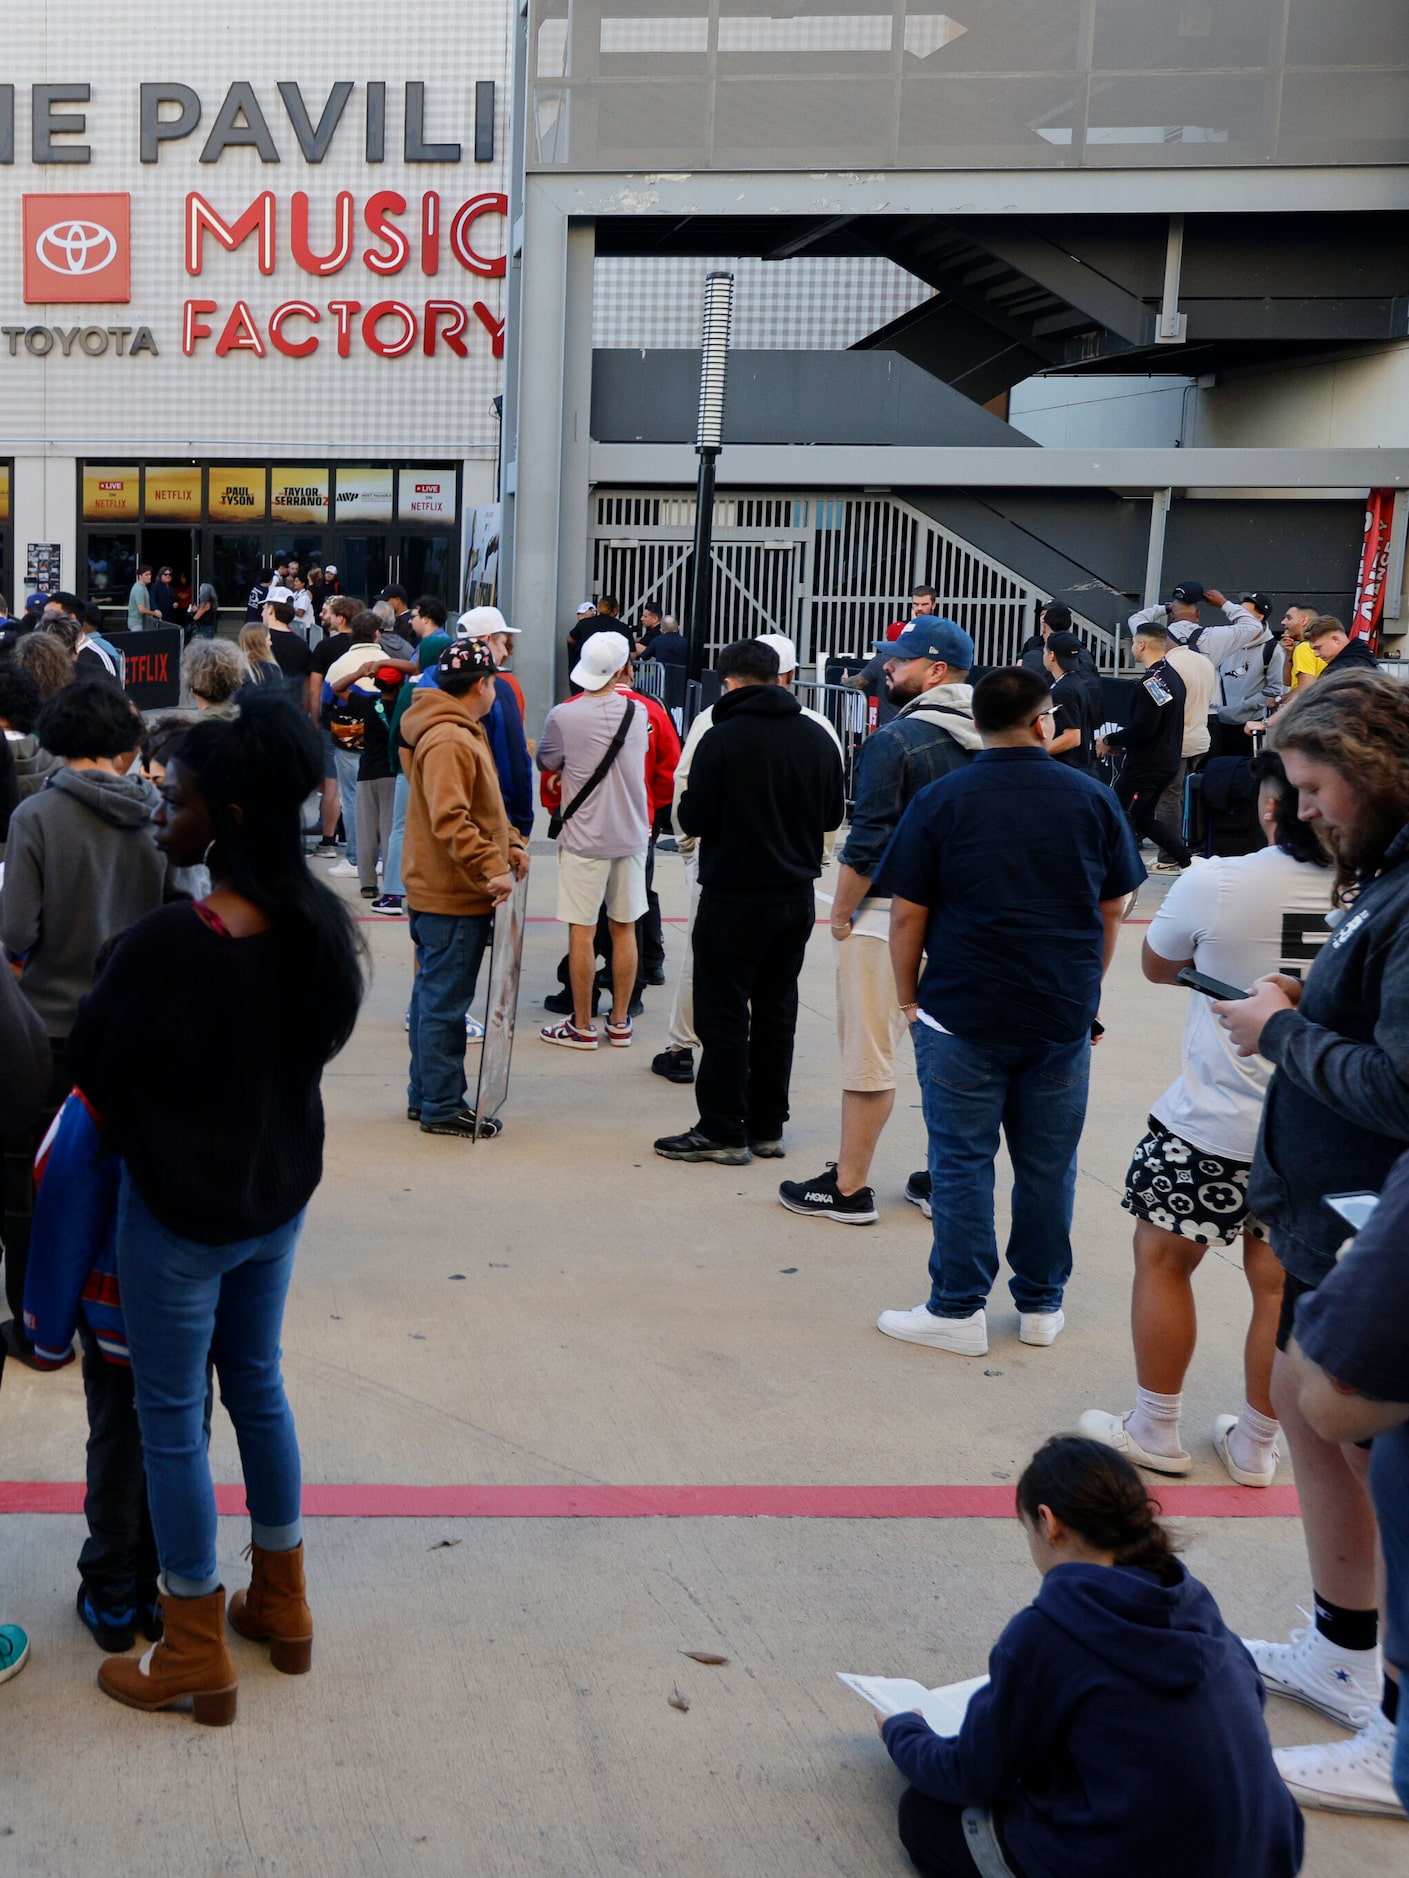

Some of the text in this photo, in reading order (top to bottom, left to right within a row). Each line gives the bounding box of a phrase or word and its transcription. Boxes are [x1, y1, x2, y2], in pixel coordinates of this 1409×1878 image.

[139, 81, 496, 164] PAVILI
[185, 190, 508, 278] MUSIC
[182, 299, 505, 359] FACTORY
[1, 326, 159, 357] TOYOTA
[226, 487, 249, 496] PAUL
[284, 487, 318, 496] TAYLOR
[421, 485, 438, 493] LIVE
[155, 490, 192, 500] NETFLIX
[95, 499, 126, 509] NETFLIX
[221, 495, 254, 506] TYSON
[411, 502, 442, 512] NETFLIX
[804, 1191, 834, 1204] HOKA
